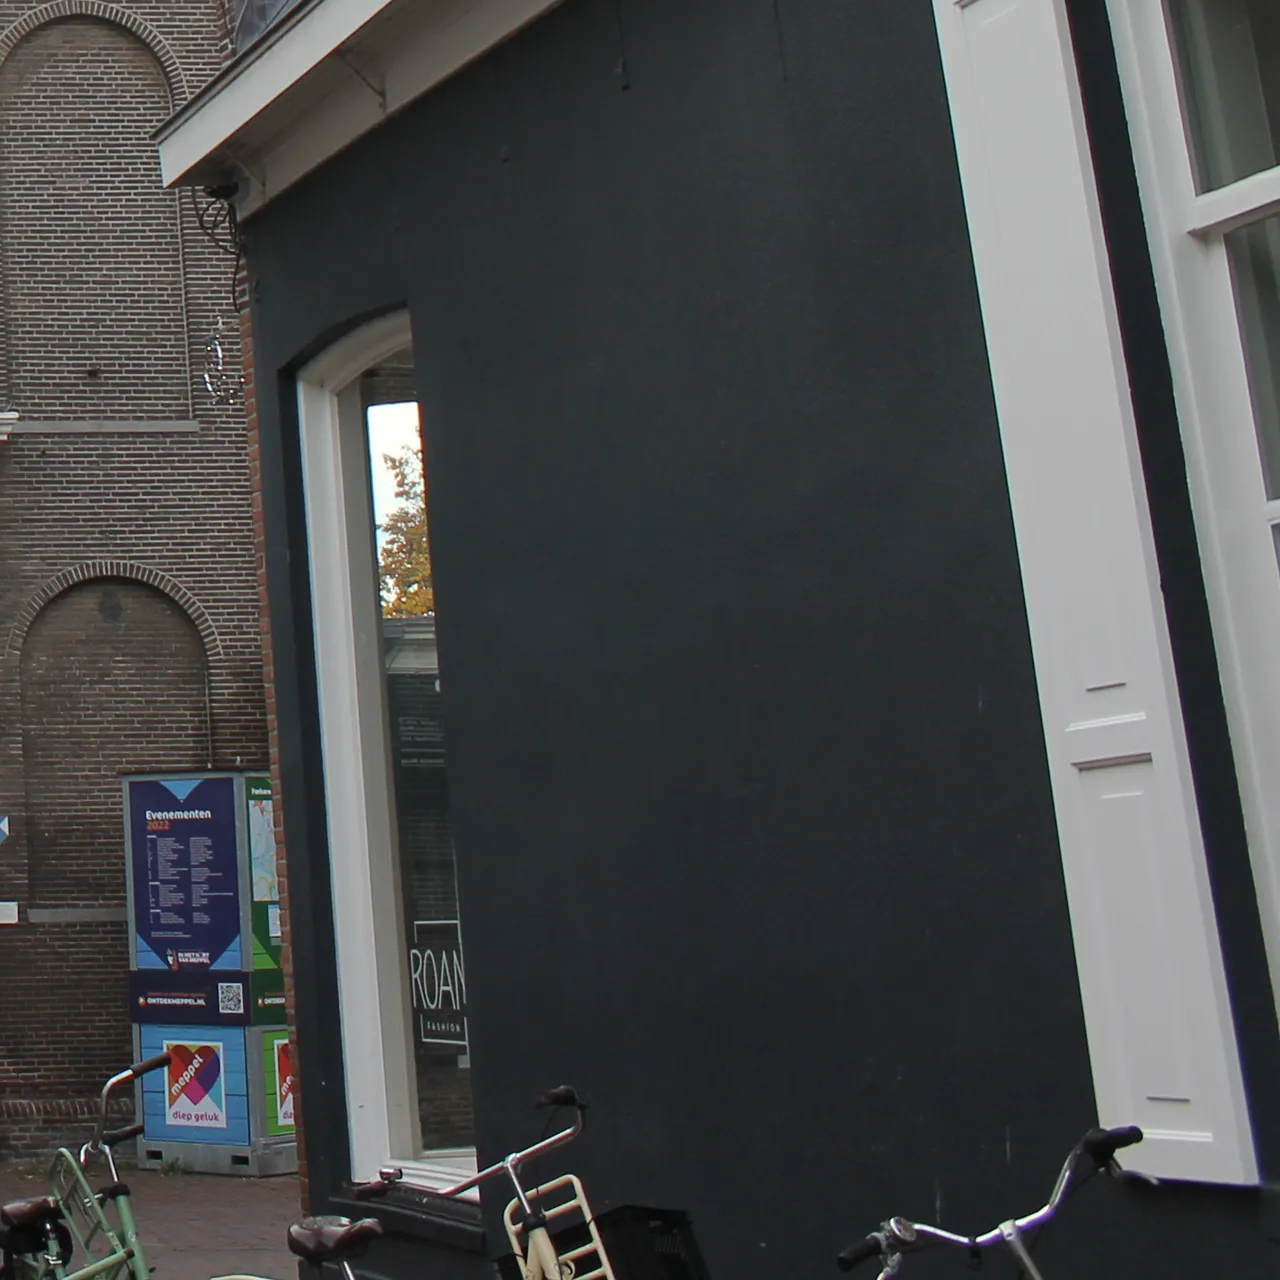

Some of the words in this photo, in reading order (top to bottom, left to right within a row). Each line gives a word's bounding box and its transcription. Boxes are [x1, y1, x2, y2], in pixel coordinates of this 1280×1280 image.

[145, 810, 212, 820] Evenementen
[146, 820, 171, 830] 2022
[427, 1021, 460, 1032] FASHION
[171, 1054, 203, 1095] meppel
[172, 1111, 192, 1120] diep
[194, 1111, 219, 1121] geluk
